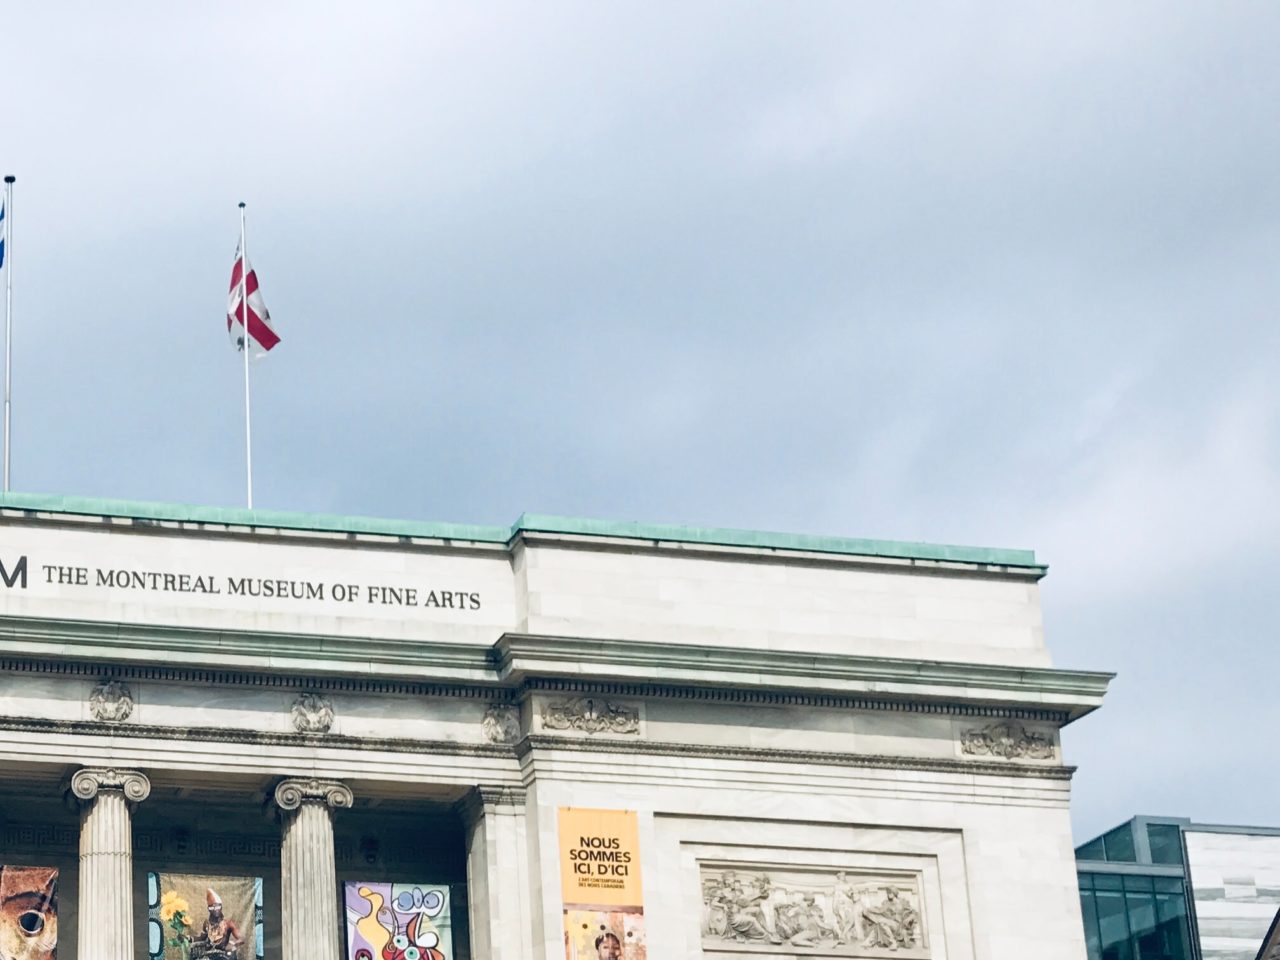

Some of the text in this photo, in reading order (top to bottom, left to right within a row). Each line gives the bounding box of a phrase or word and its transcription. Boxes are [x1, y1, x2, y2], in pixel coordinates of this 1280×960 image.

[42, 565, 481, 611] THE MONTREAL MUSEUM OF FINE ARTS
[580, 836, 620, 850] NOUS
[570, 849, 631, 863] SOMMES
[574, 862, 628, 876] ICI, D'ICI
